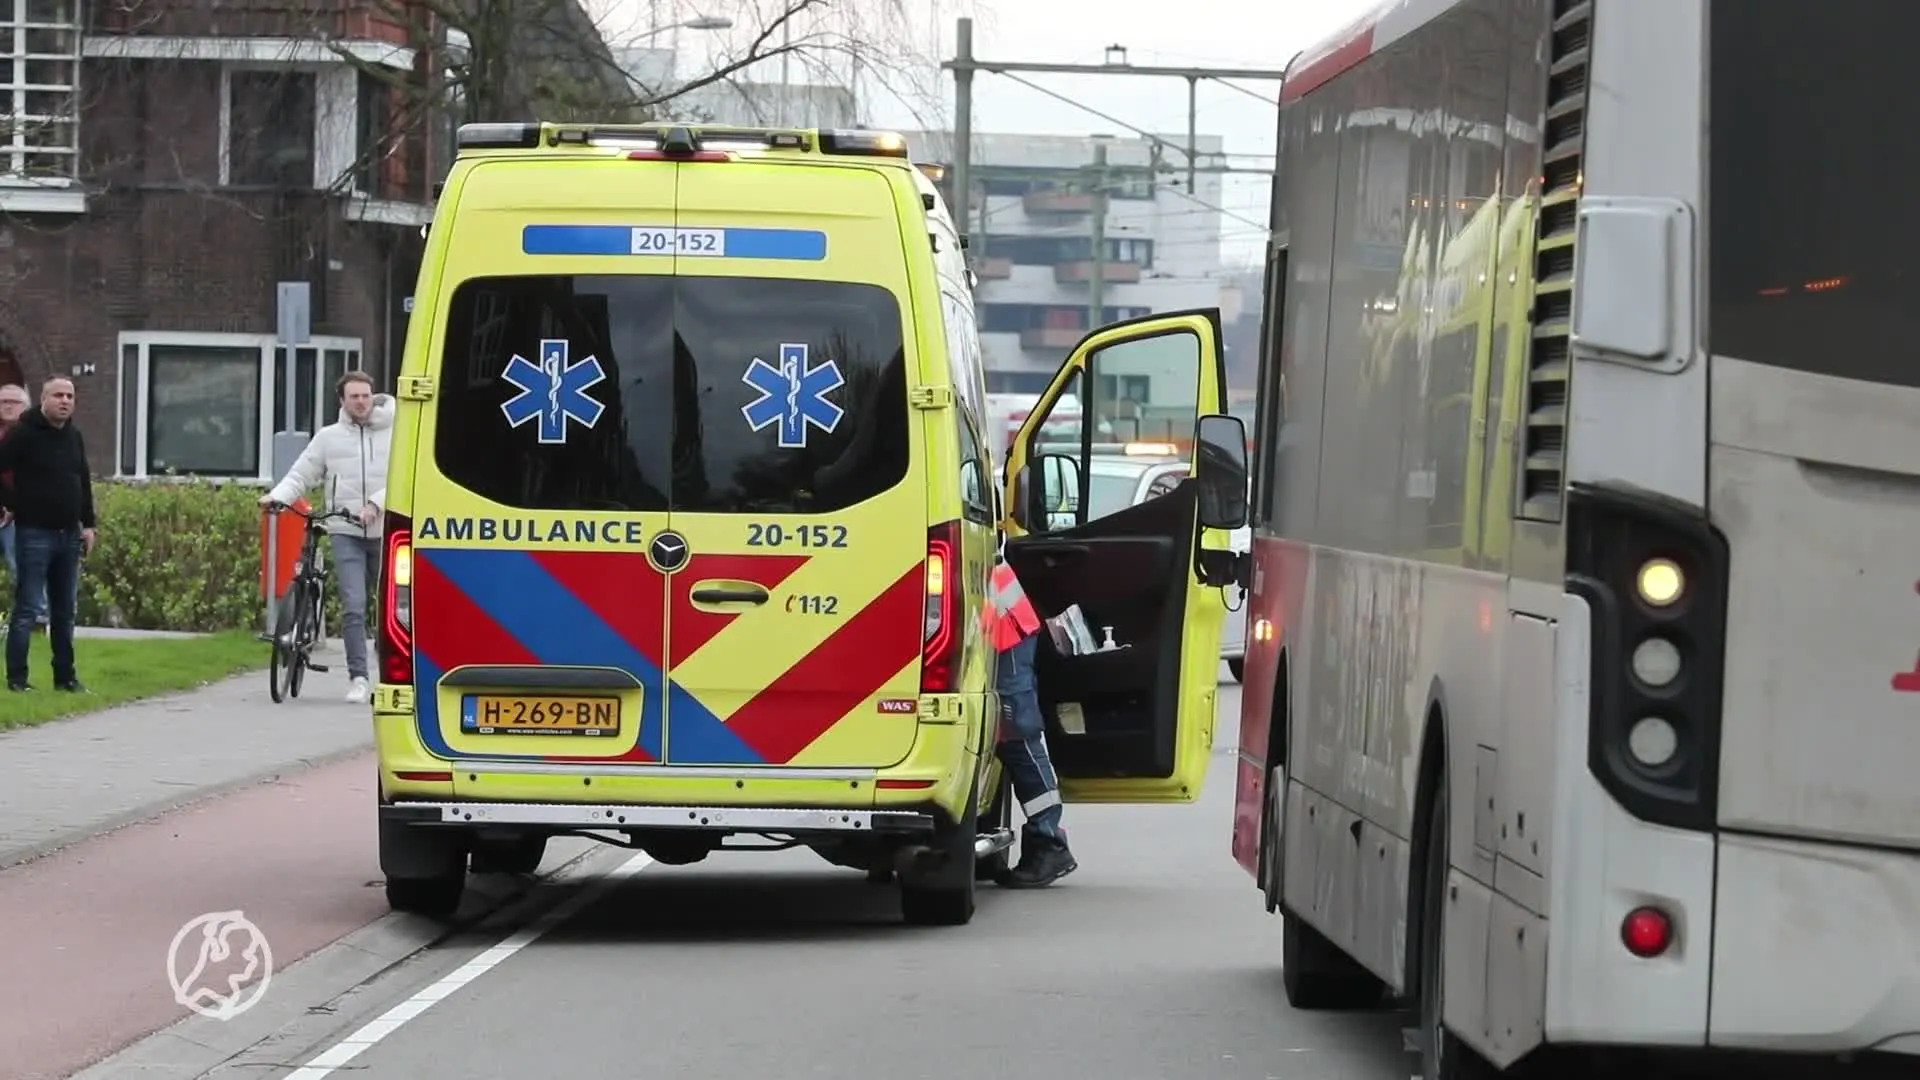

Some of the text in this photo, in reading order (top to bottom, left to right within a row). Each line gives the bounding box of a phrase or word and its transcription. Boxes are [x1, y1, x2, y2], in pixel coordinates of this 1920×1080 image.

[639, 232, 716, 251] 20-152
[418, 517, 642, 544] AMBULANCE
[746, 523, 848, 548] 20-152
[484, 700, 611, 726] H-269-BN
[882, 701, 911, 711] WAS
[464, 715, 475, 723] NL
